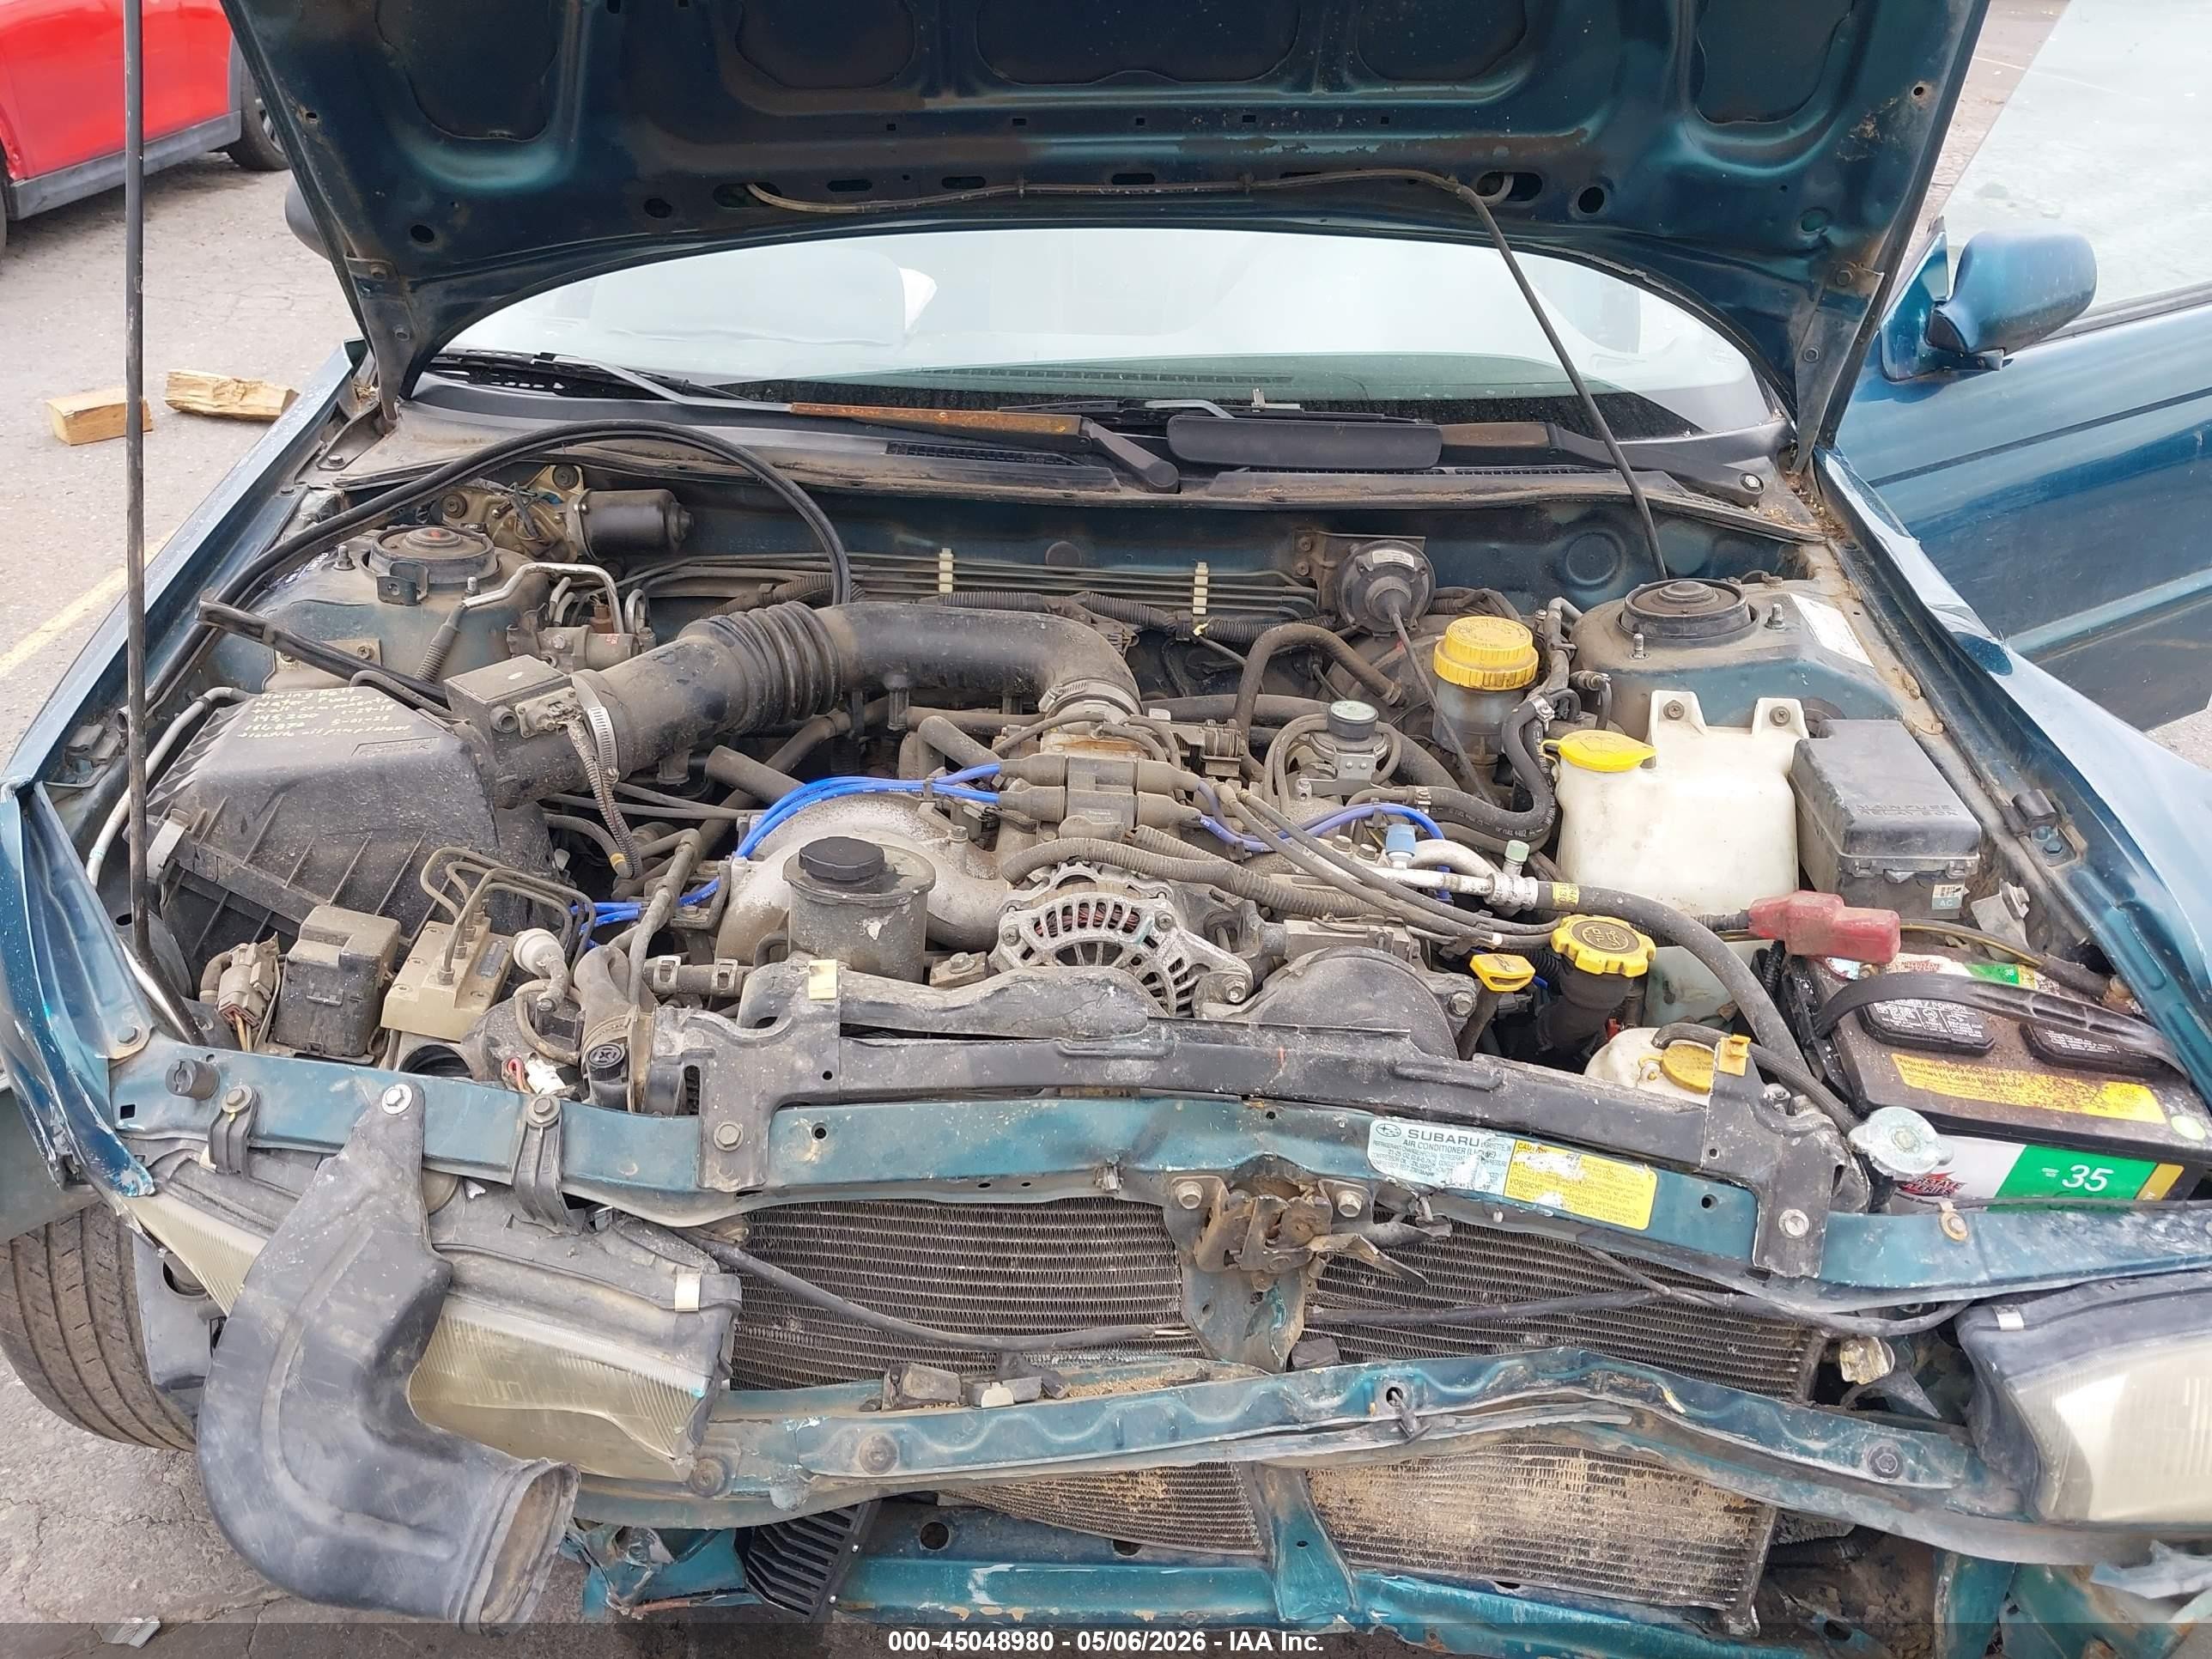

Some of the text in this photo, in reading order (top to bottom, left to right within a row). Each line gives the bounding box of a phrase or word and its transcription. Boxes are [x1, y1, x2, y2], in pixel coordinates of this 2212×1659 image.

[1402, 1139, 1416, 1149] AIR
[1418, 1141, 1466, 1154] CONDITIONER
[1408, 1128, 1480, 1147] SUBARU
[2062, 1164, 2114, 1192] 35
